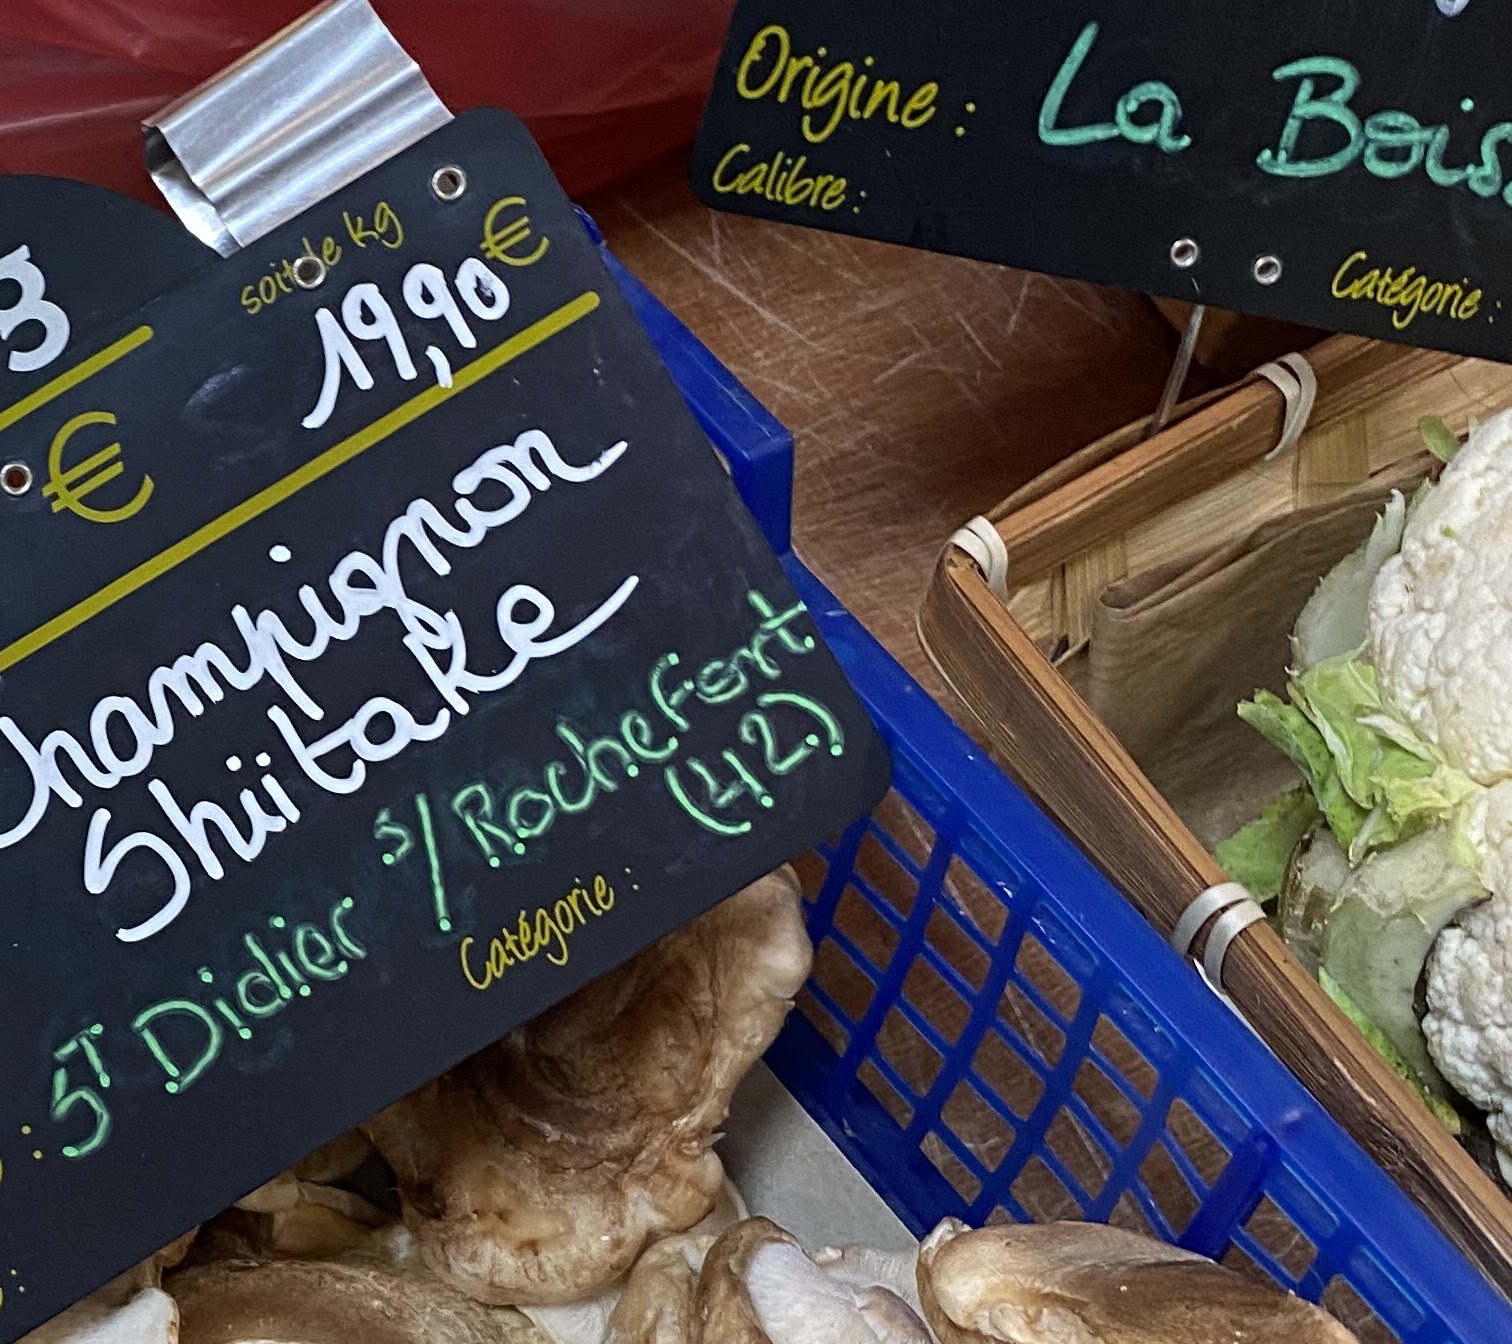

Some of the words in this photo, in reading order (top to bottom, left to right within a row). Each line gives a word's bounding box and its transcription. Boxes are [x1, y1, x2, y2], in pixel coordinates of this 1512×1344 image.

[735, 23, 938, 144] Origine
[1036, 21, 1190, 155] La
[1256, 55, 1512, 208] Bois
[343, 201, 404, 250] kg
[710, 143, 848, 212] Calibre
[1331, 250, 1482, 330] Catégorie
[41, 410, 155, 524] €
[662, 689, 846, 833] (42)
[460, 877, 616, 992] Catégorie
[132, 896, 368, 1095] Didier
